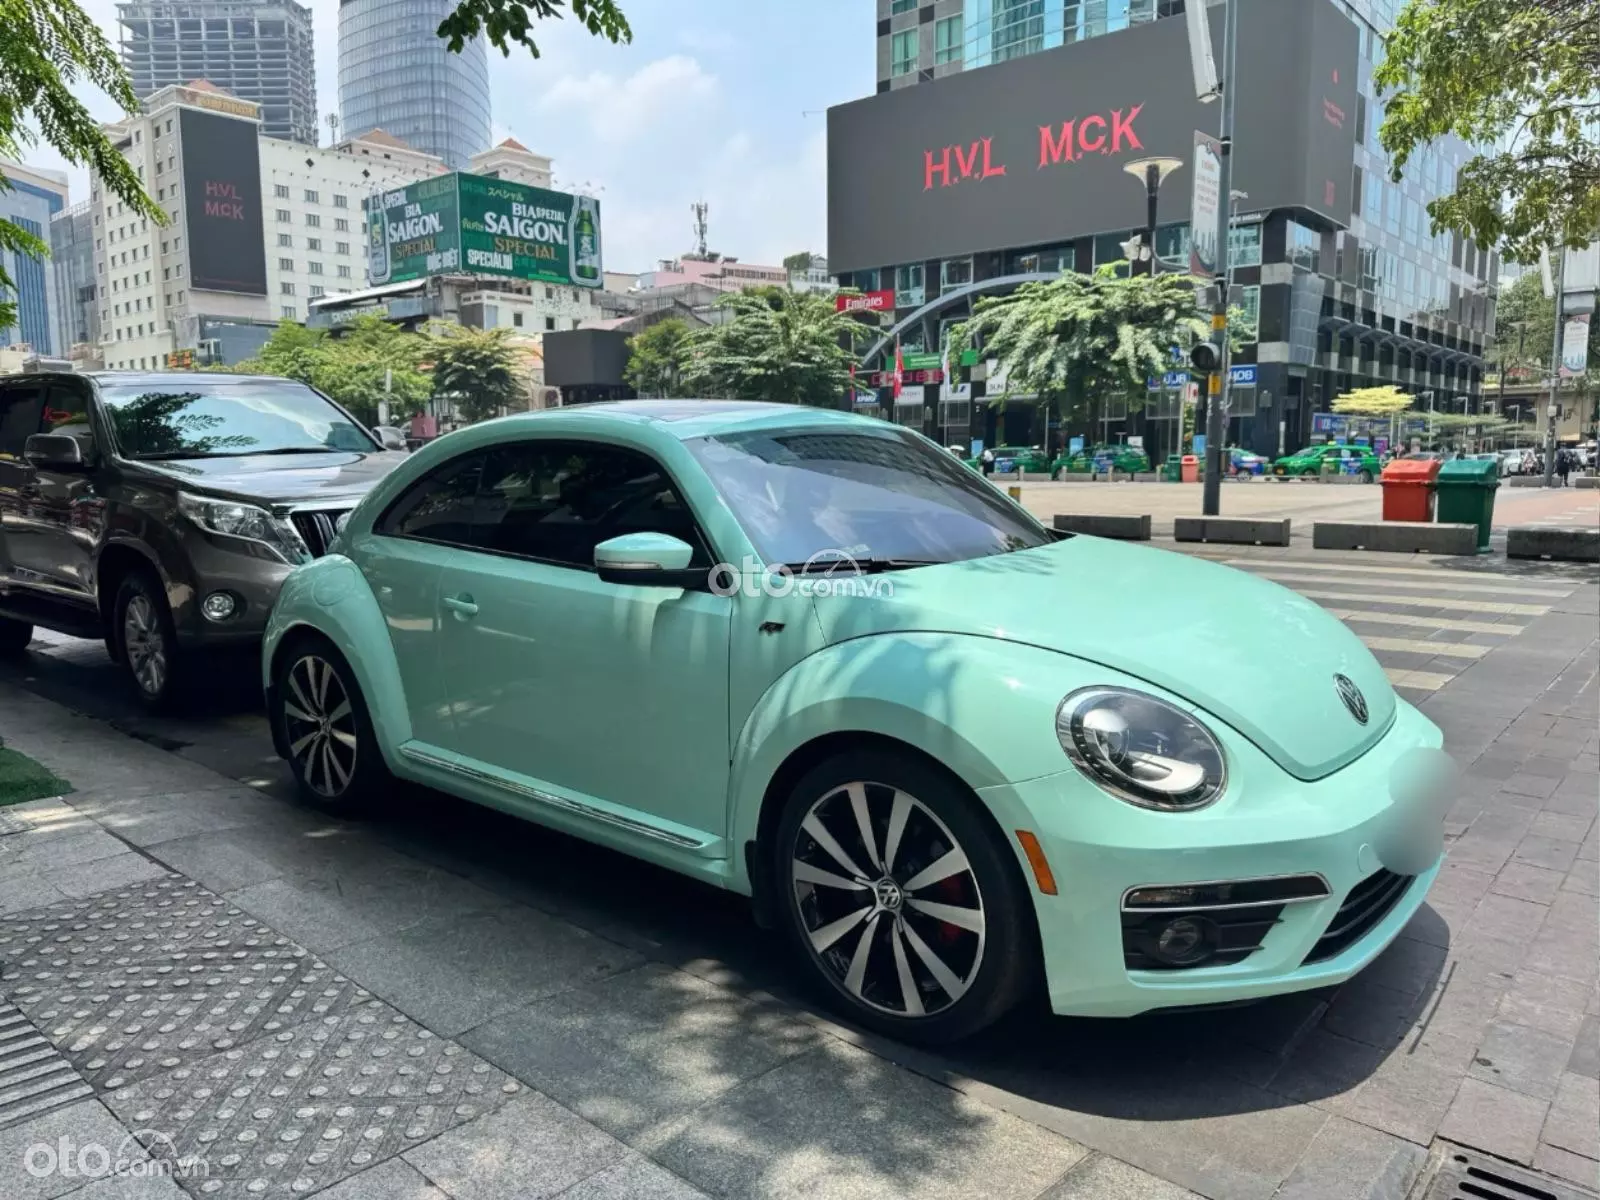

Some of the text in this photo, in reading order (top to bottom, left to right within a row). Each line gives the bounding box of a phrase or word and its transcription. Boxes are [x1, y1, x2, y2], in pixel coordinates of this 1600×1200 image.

[404, 202, 422, 219] BIA
[512, 202, 537, 219] BIA
[395, 236, 436, 258] SPECIAL
[494, 237, 560, 260] SPECIAL
[845, 293, 883, 310] Emirates
